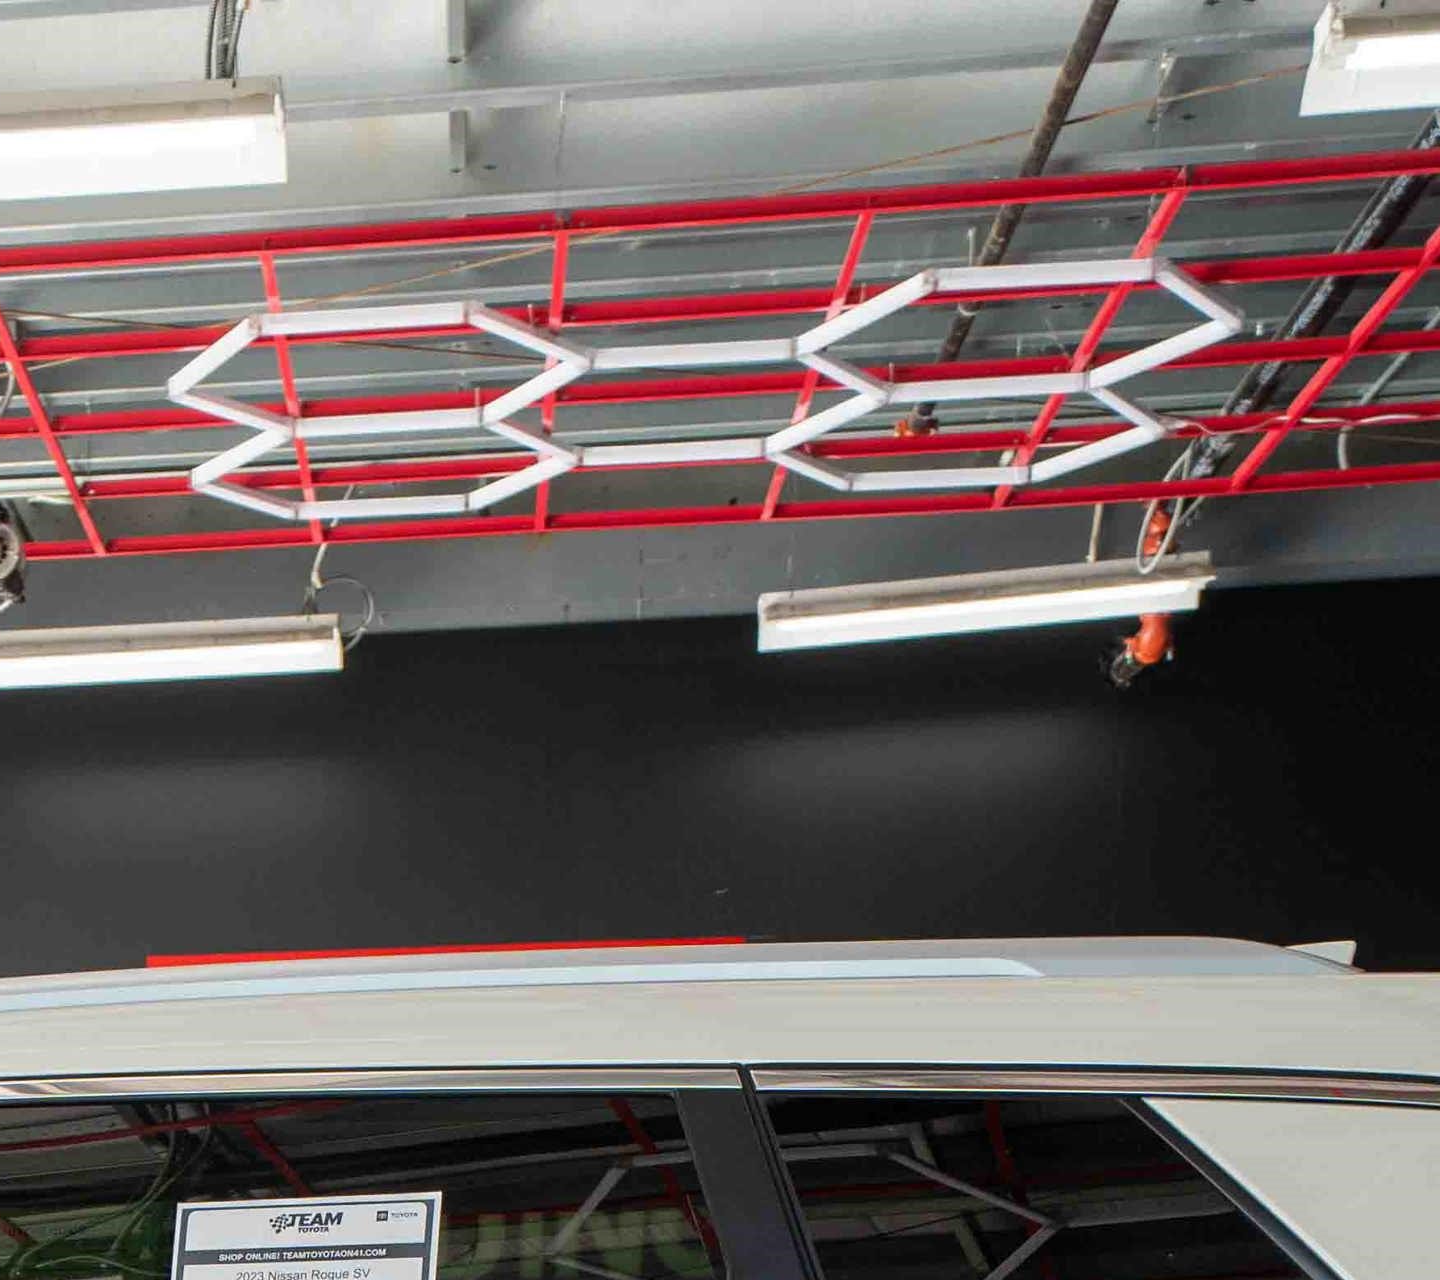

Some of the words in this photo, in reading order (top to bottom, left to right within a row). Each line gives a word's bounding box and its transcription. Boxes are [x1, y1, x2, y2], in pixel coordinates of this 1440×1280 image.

[288, 1212, 344, 1226] TEAM
[391, 1211, 419, 1219] TOYOTA
[297, 1225, 330, 1234] TOYOTA
[218, 1252, 245, 1262] SHOP
[245, 1250, 280, 1261] ONLINE!
[281, 1248, 387, 1260] TEAMTOYOTAON41.COM
[353, 1267, 371, 1279] SV
